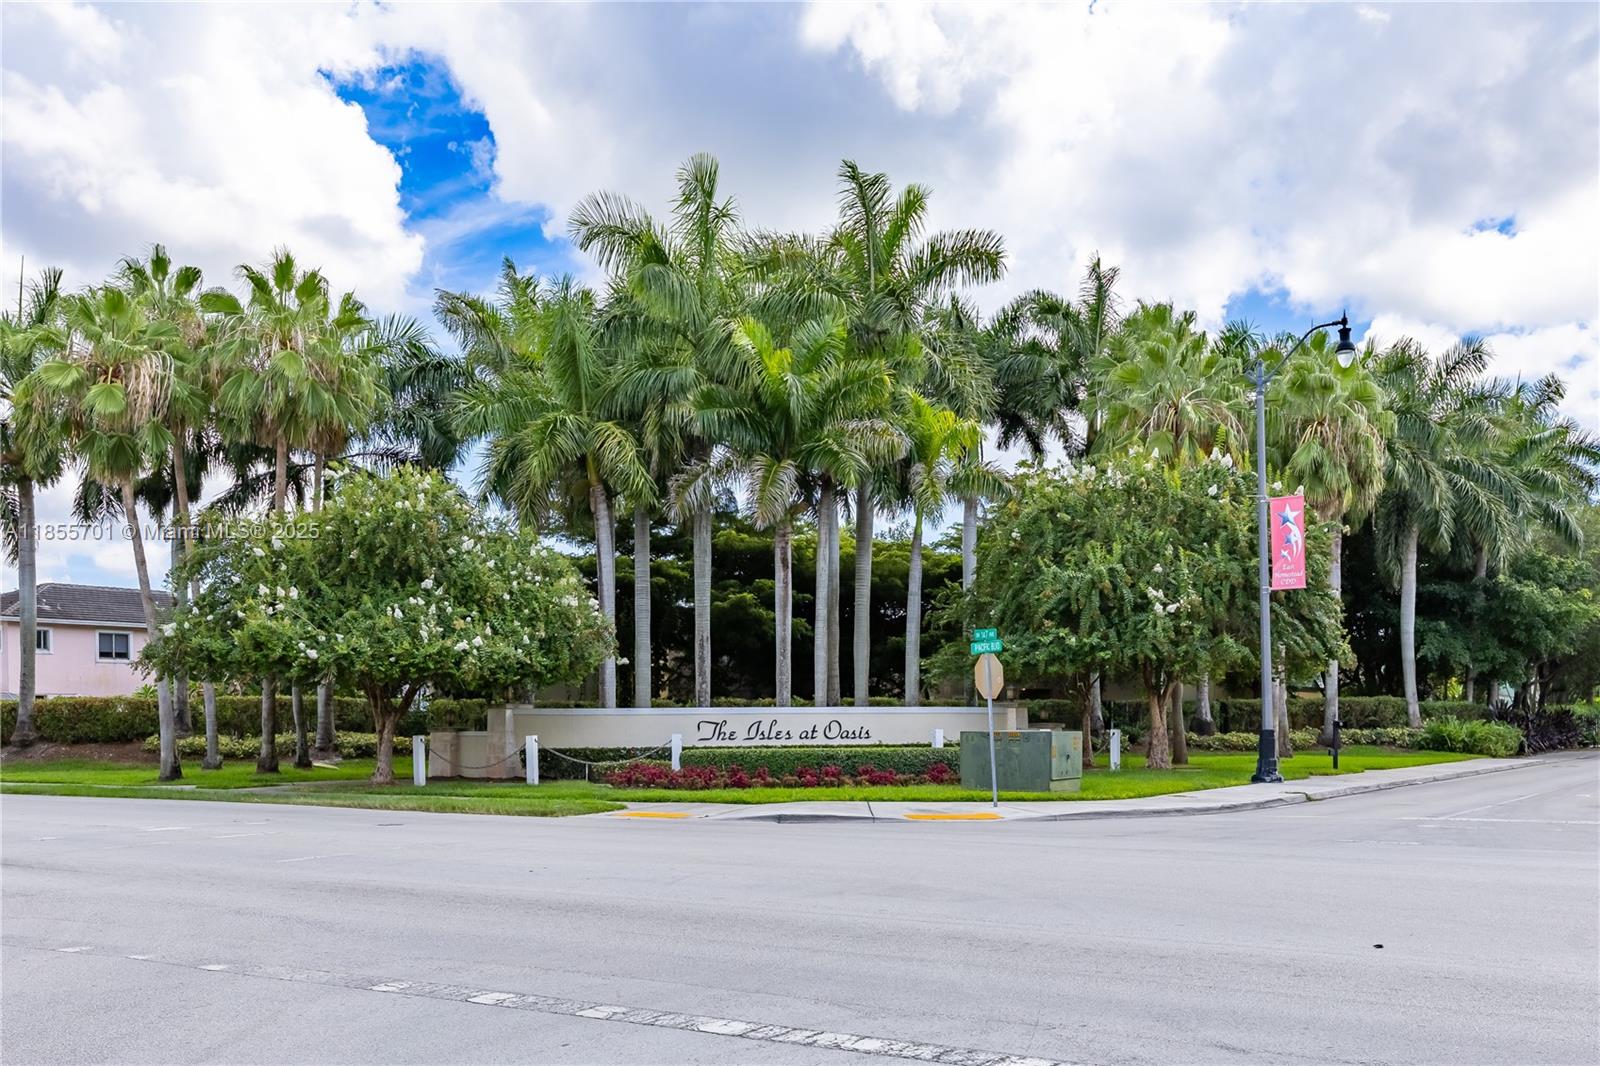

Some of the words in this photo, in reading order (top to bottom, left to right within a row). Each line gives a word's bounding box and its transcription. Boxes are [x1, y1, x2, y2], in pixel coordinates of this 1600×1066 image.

[974, 642, 990, 652] PACIFIC
[697, 720, 738, 742] The
[743, 719, 793, 741] Isles
[799, 724, 818, 740] at
[823, 719, 872, 740] Oasis
